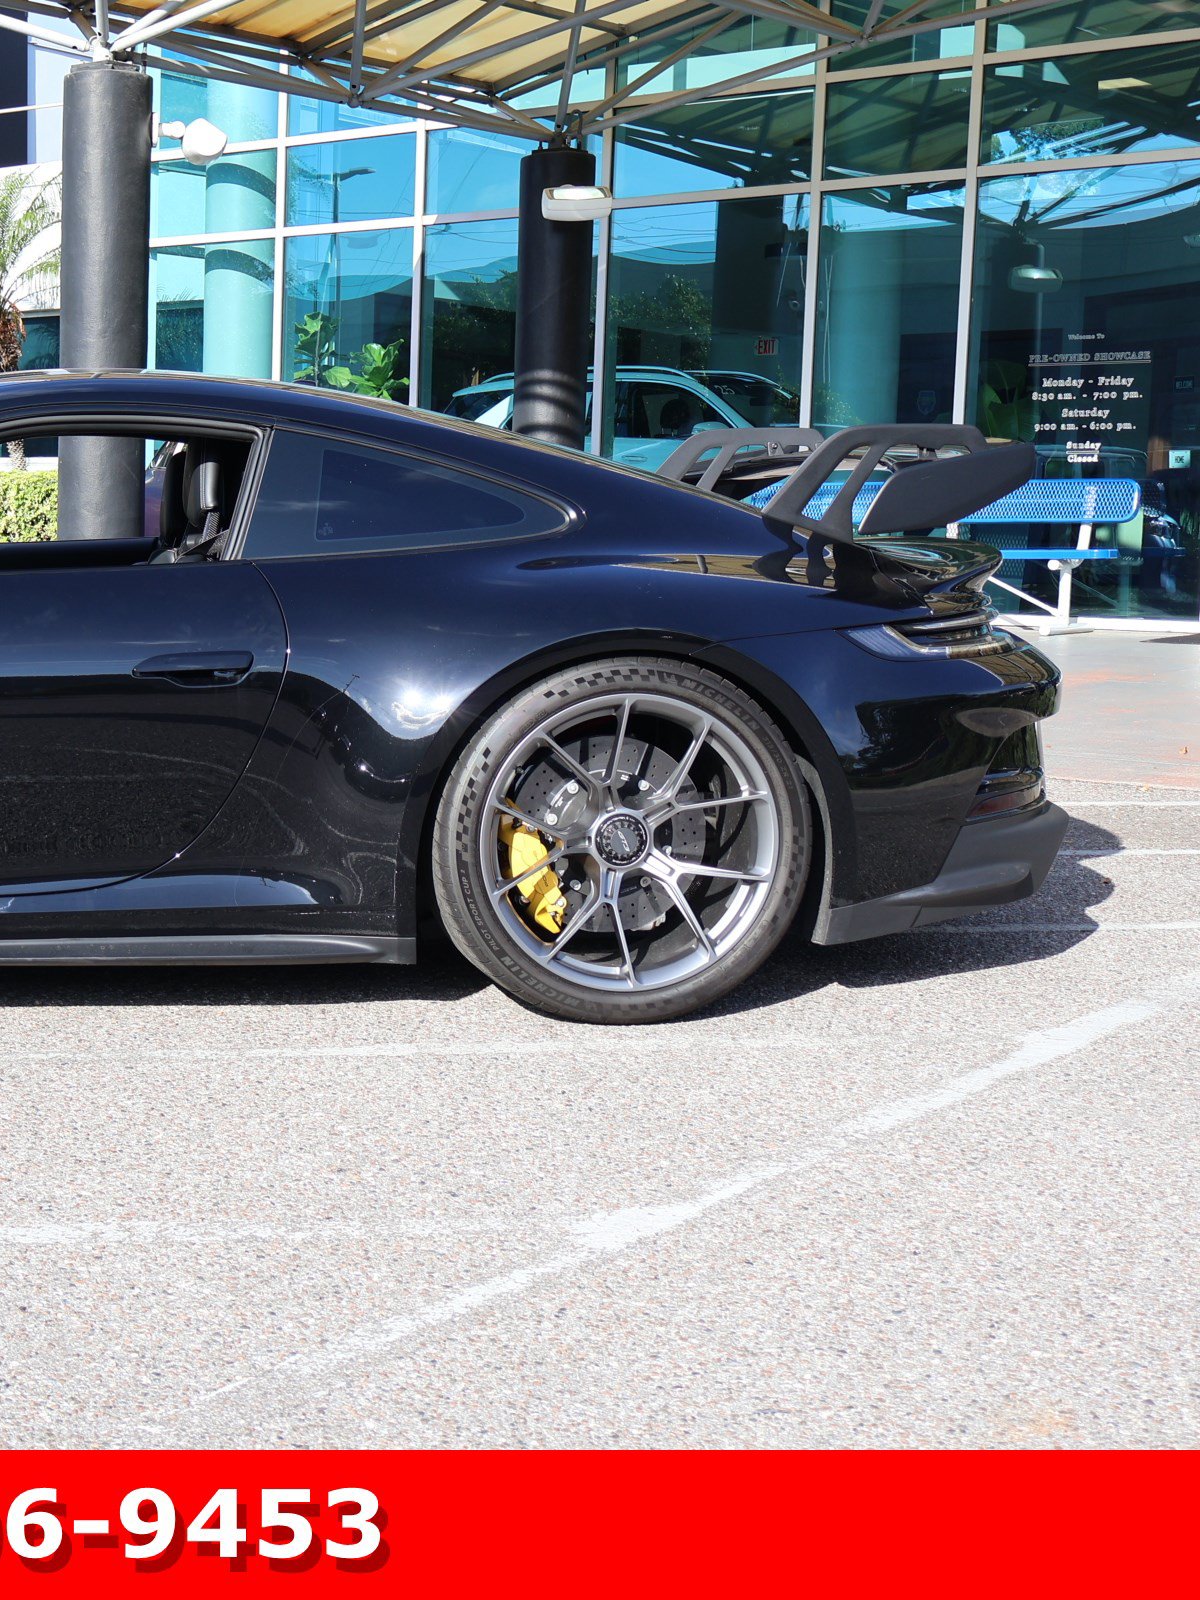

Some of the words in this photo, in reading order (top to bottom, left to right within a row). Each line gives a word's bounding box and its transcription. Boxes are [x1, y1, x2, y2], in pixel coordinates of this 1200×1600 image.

[1067, 333, 1096, 341] Welcome
[1096, 332, 1105, 340] To
[758, 339, 776, 355] EXIT
[1029, 352, 1091, 363] PRE-OWNED
[1093, 350, 1152, 361] SHOWCASE
[1042, 376, 1084, 389] Monday
[1097, 375, 1135, 387] Friday
[1031, 391, 1055, 402] 8:30
[1057, 392, 1077, 400] am.
[1093, 391, 1118, 401] 7:00
[1122, 390, 1143, 400] pm.
[1061, 406, 1111, 419] Saturday
[1034, 422, 1057, 431] 9:00
[1060, 422, 1079, 430] am.
[1089, 421, 1114, 431] 6:00
[1116, 421, 1137, 432] pm.
[1065, 440, 1102, 450] Sunday
[1066, 454, 1099, 463] Closed
[680, 678, 760, 730] MICHELIN
[460, 876, 471, 895] CUP
[467, 898, 484, 926] SPORT
[482, 929, 500, 951] PILOT
[501, 954, 580, 1008] MICHELIN
